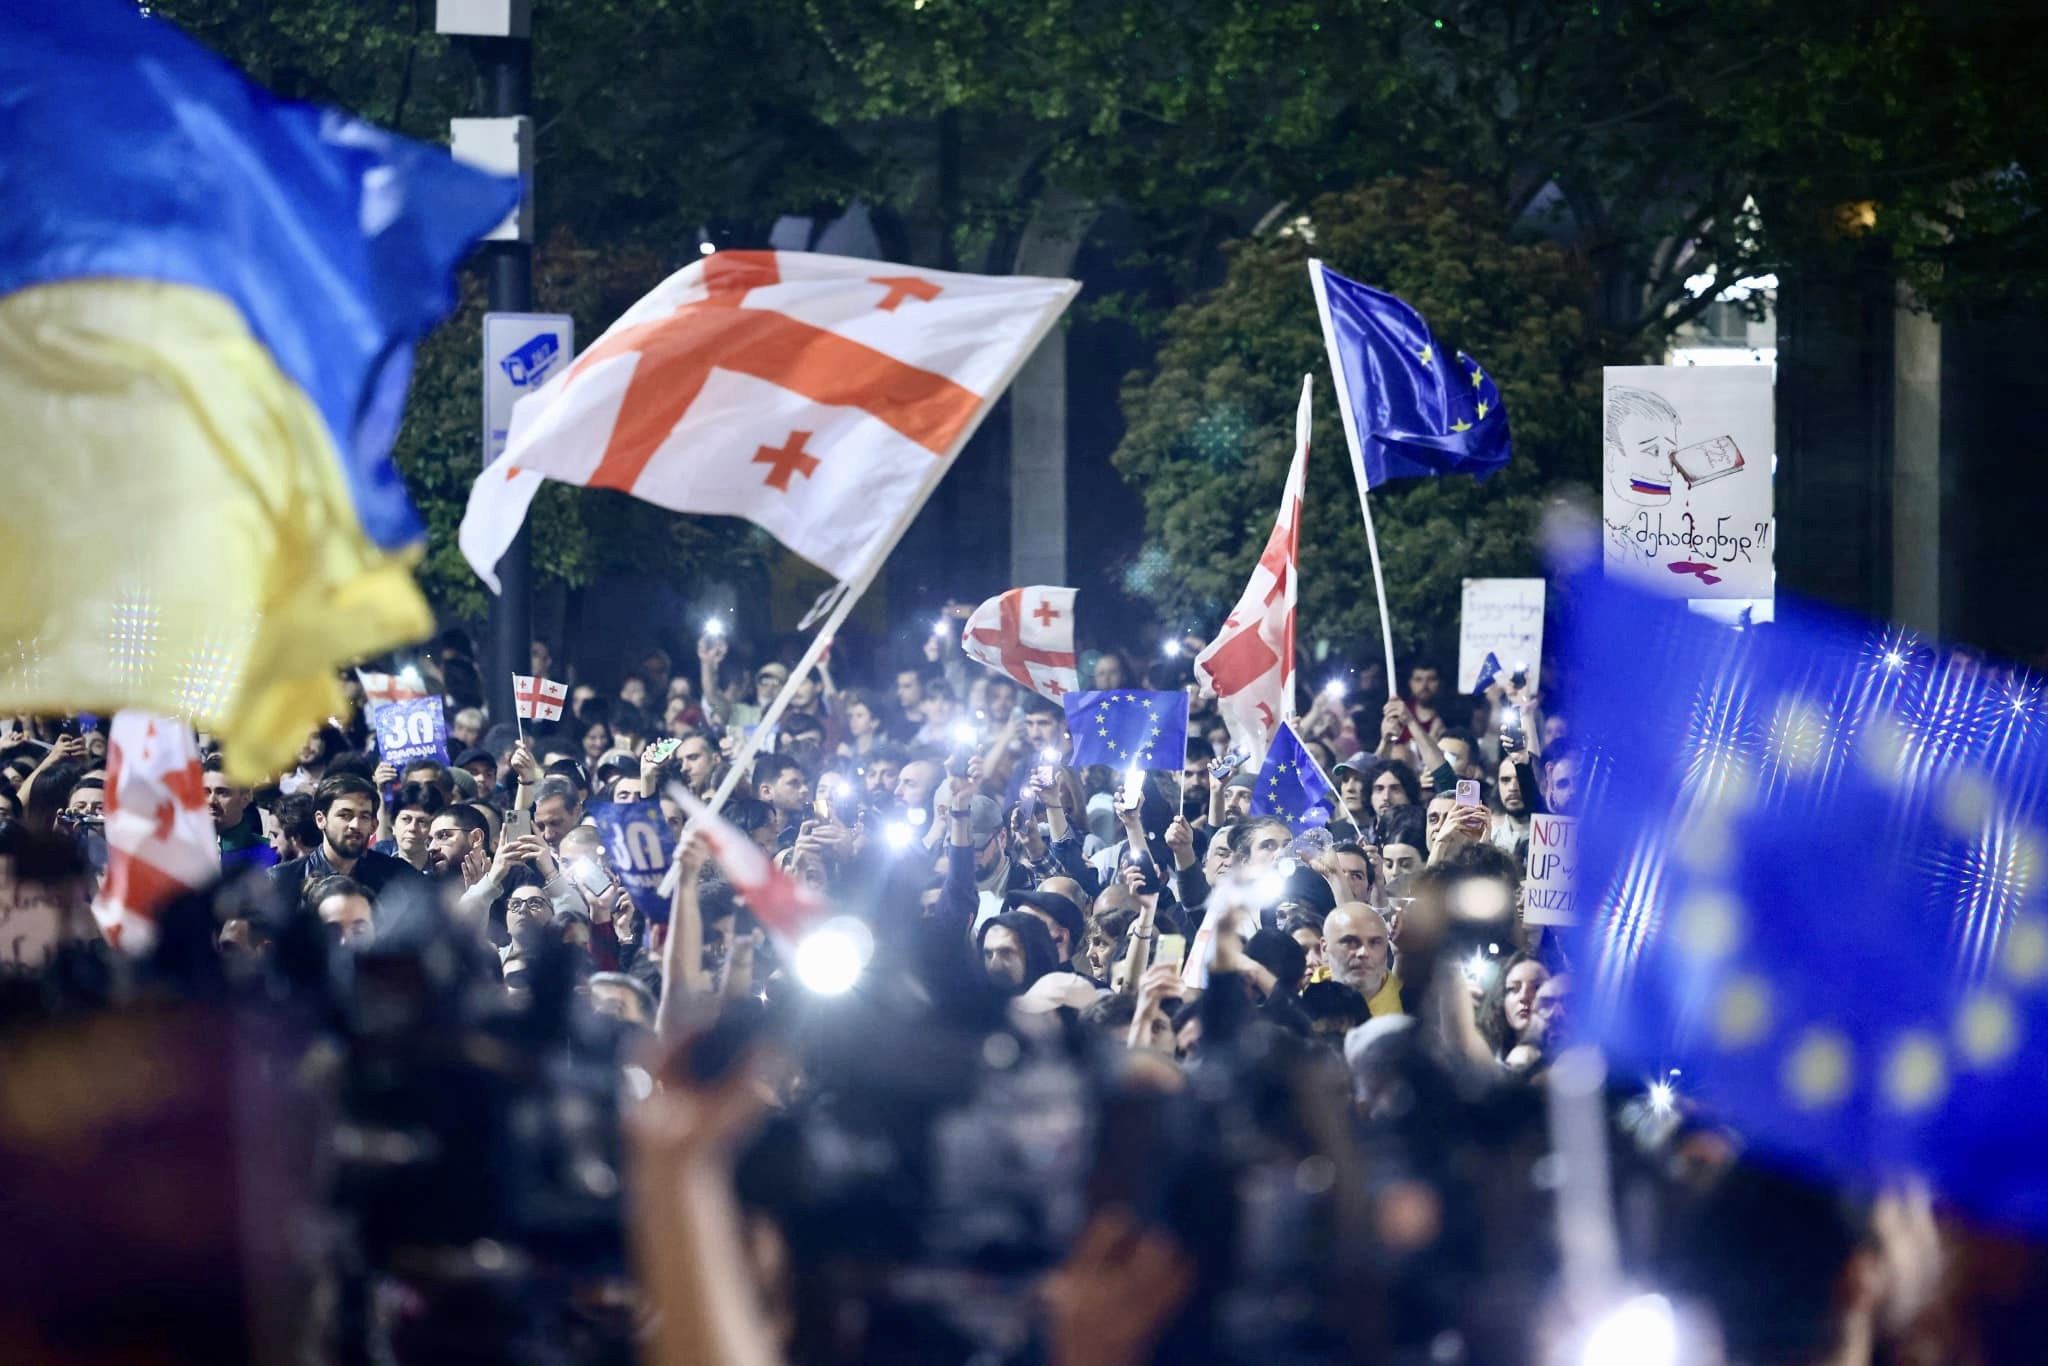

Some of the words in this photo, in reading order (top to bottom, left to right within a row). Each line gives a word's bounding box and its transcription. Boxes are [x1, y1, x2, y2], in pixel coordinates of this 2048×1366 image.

[384, 711, 435, 750] კი
[1533, 818, 1577, 848] NOT
[1531, 853, 1560, 880] UP
